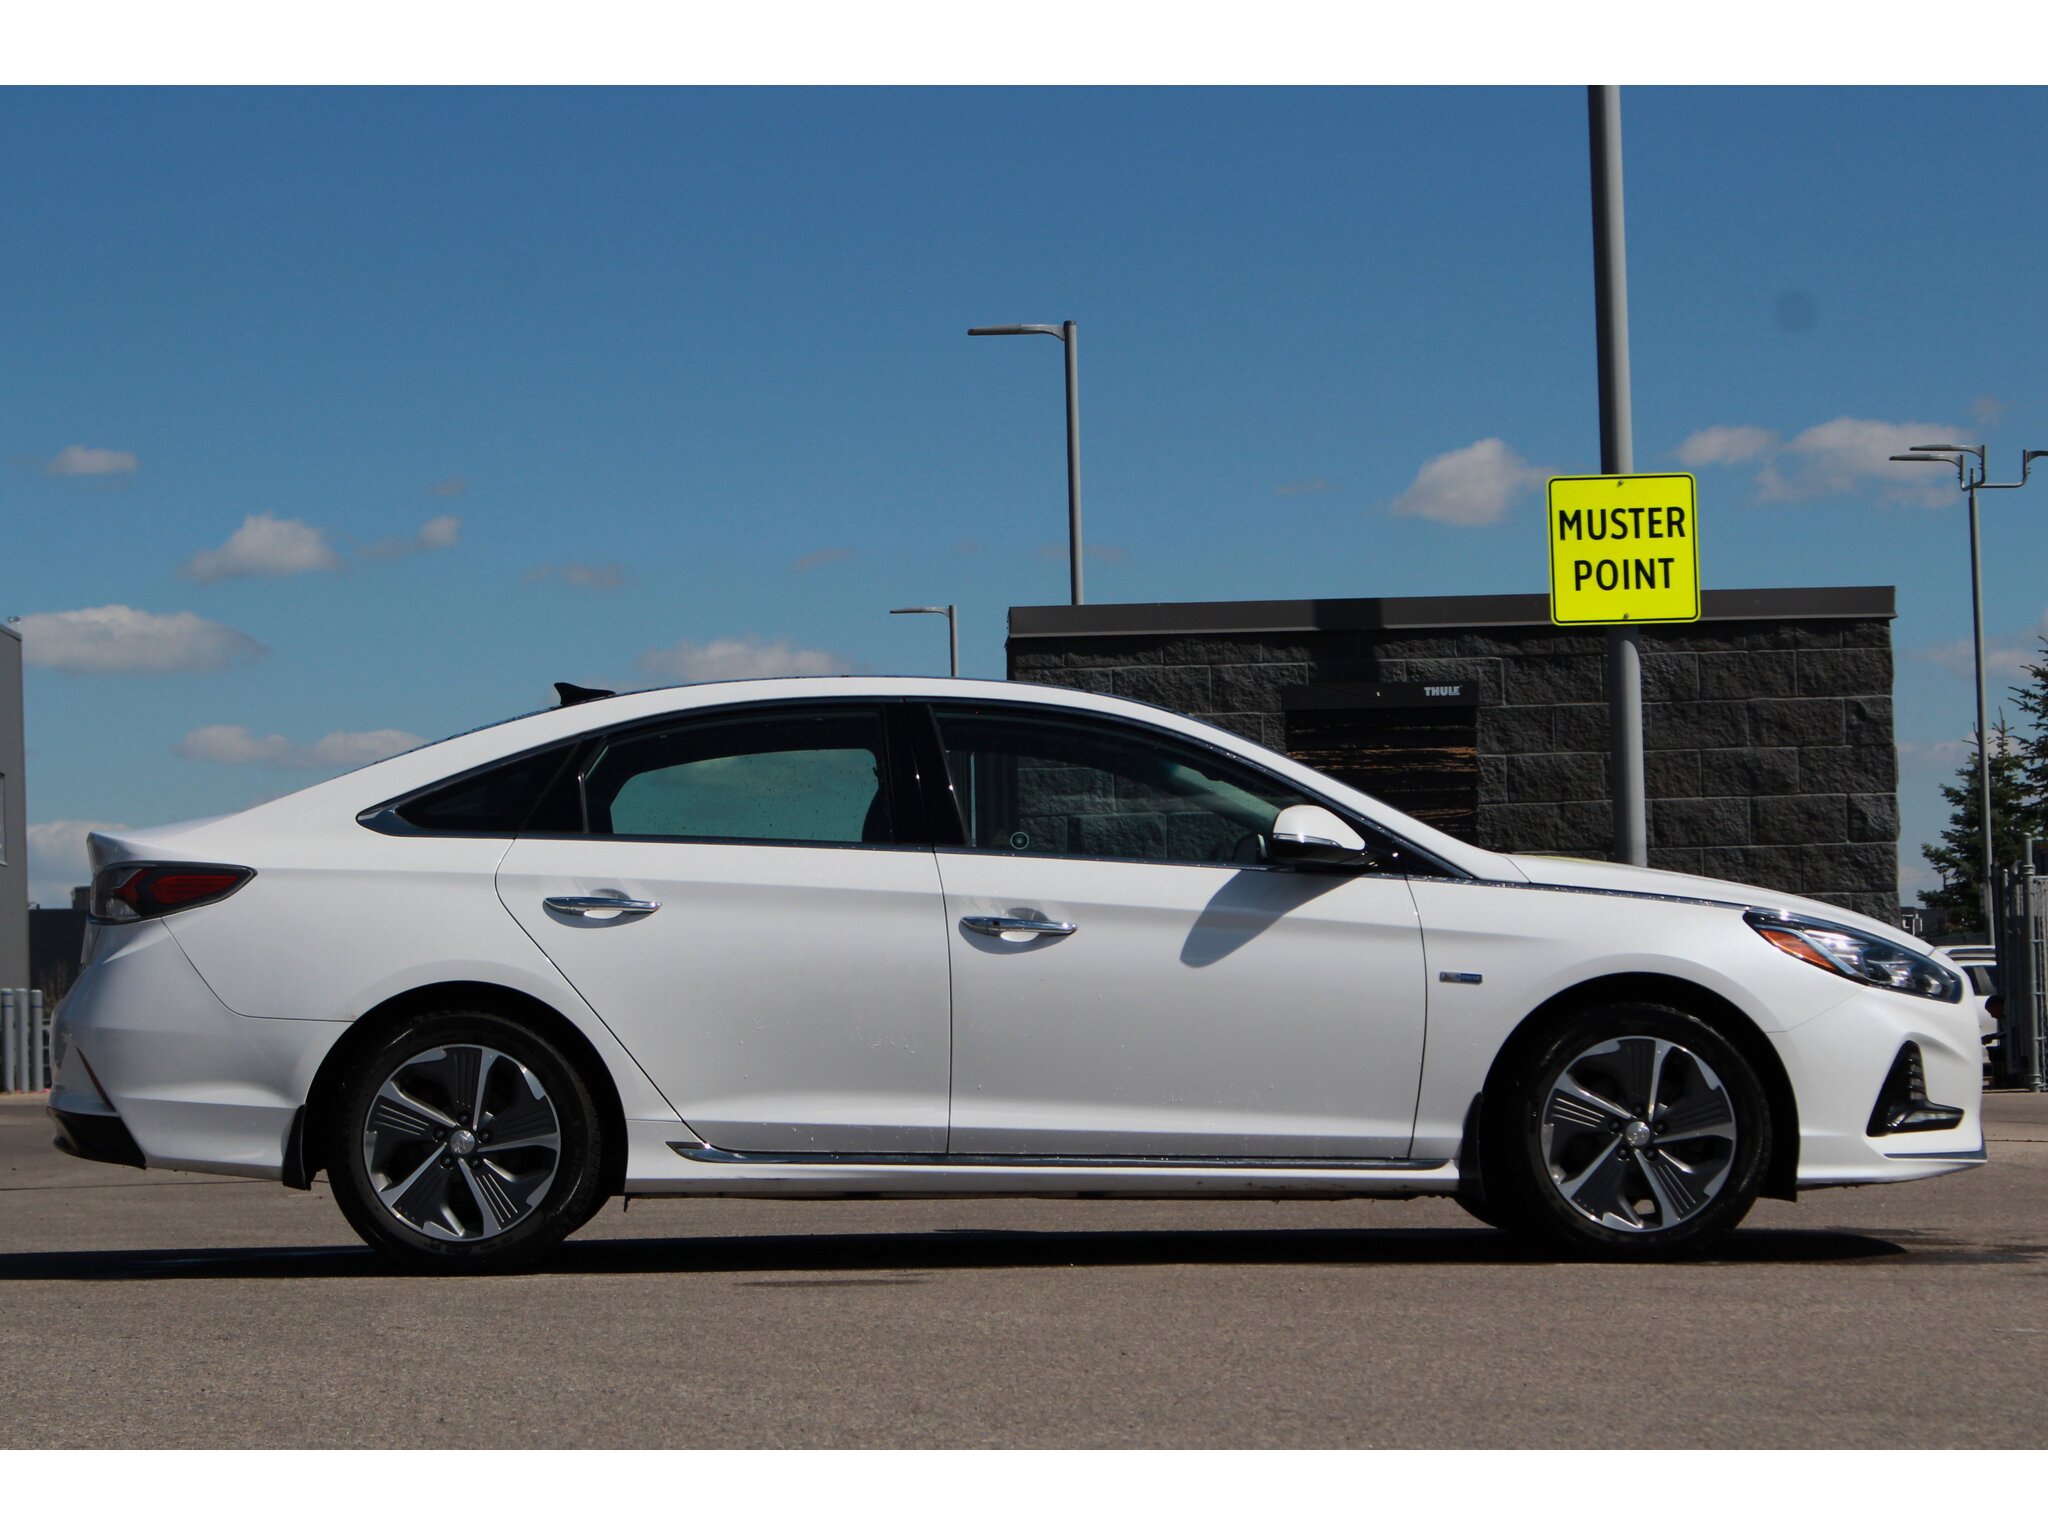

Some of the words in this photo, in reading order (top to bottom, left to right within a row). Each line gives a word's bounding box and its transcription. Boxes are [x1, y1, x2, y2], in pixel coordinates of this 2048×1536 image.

[1559, 507, 1686, 541] MUSTER
[1574, 557, 1675, 591] POINT
[1423, 686, 1461, 697] THULE
